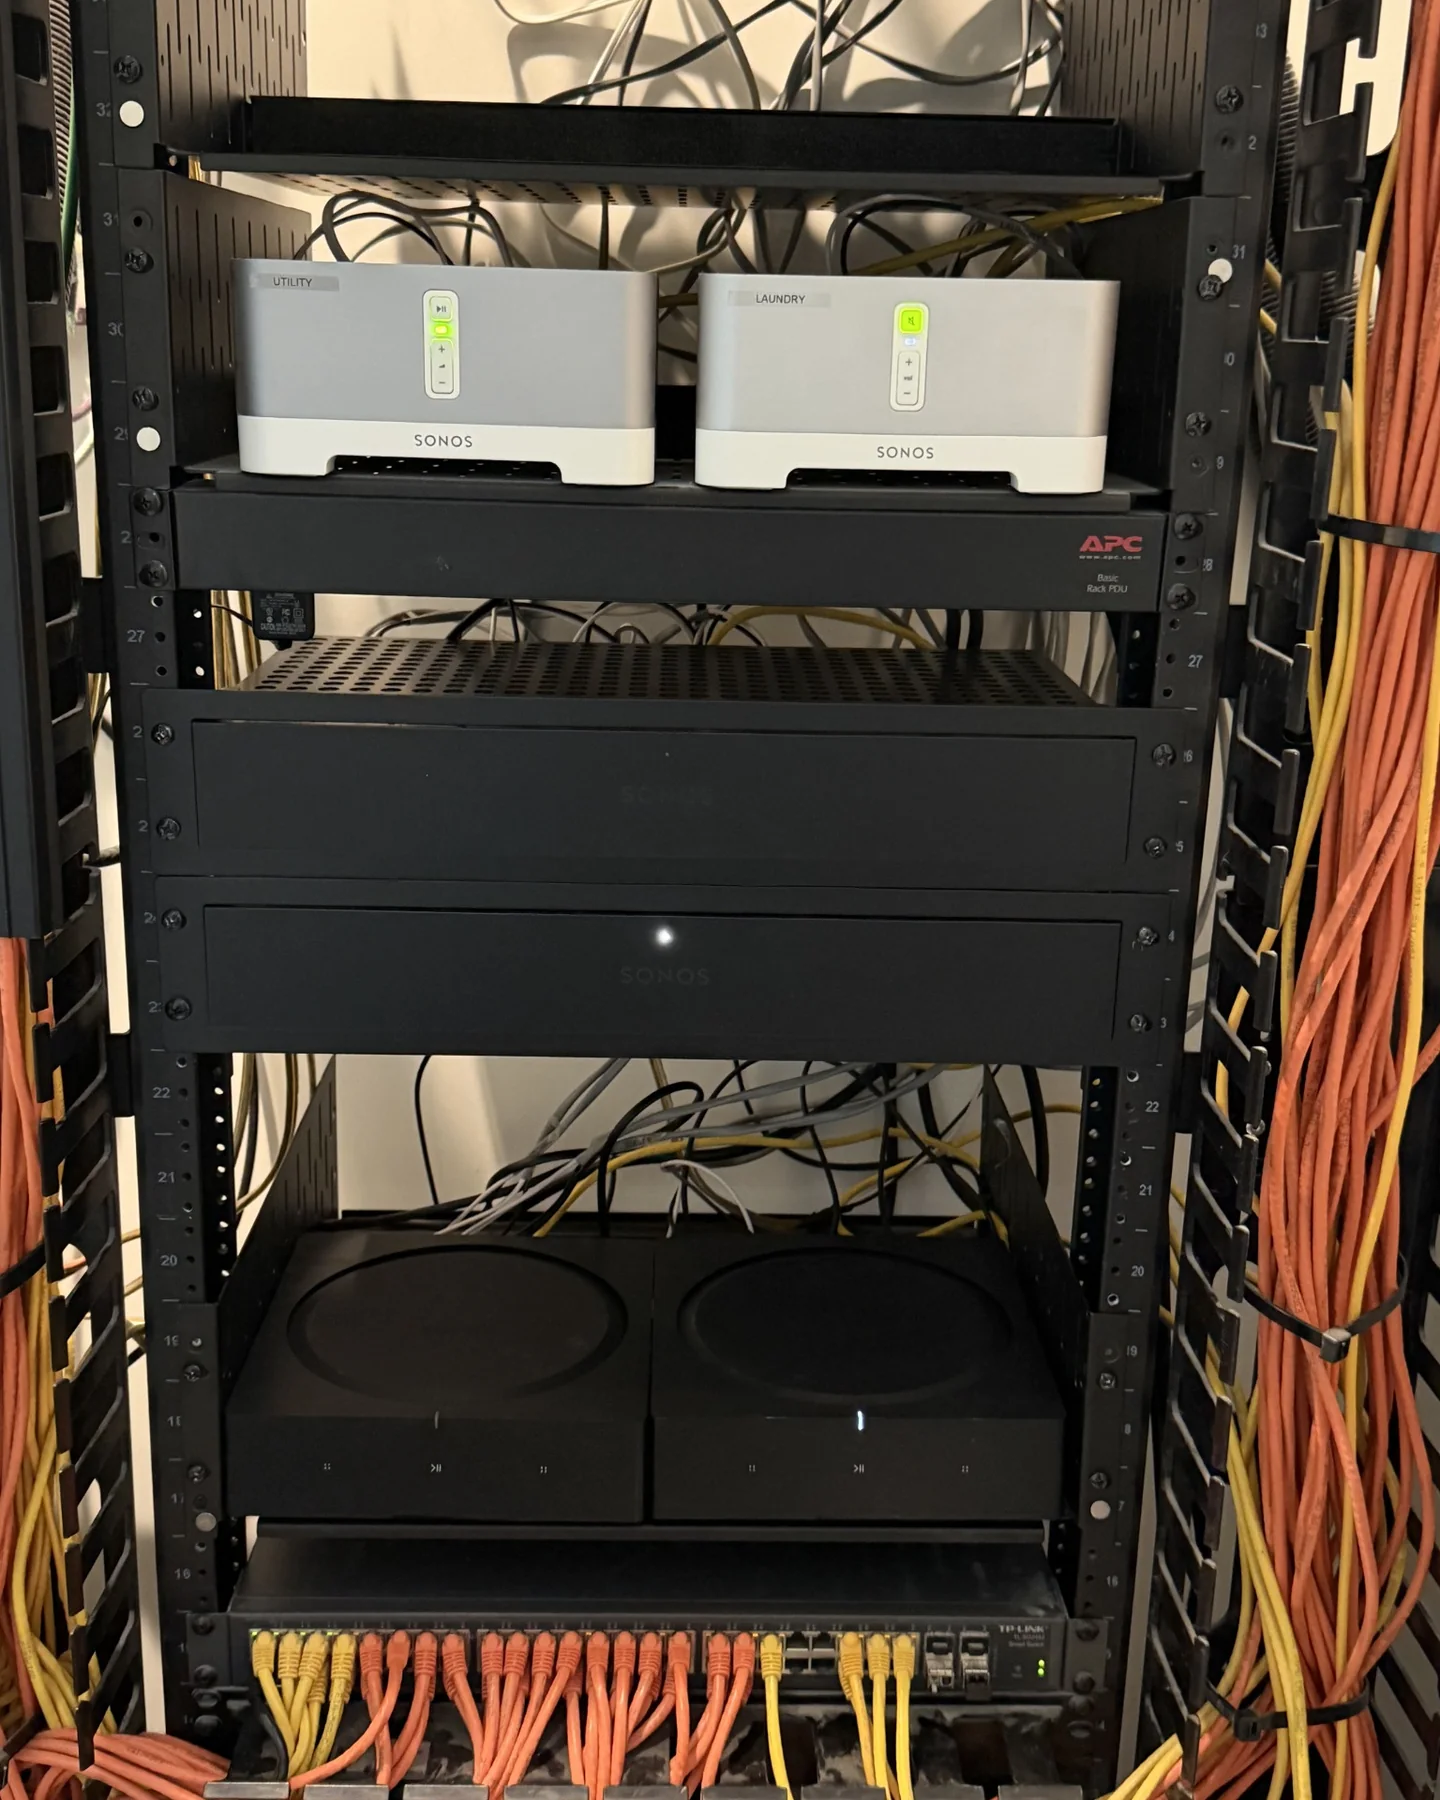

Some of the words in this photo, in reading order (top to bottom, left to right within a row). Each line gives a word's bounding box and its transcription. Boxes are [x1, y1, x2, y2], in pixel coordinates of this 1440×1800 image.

[1233, 244, 1246, 260] 31
[273, 276, 313, 287] UTILITY
[756, 294, 806, 304] LAUNDRY
[414, 434, 473, 448] SONOS
[877, 446, 934, 459] SONOS
[1080, 535, 1143, 553] APC
[1097, 573, 1119, 583] Basic
[1087, 584, 1106, 593] Rack
[1108, 584, 1128, 593] PDU
[127, 629, 146, 643] 27
[1188, 654, 1204, 669] 27
[619, 966, 710, 986] SONOS
[153, 1086, 171, 1099] 22
[1145, 1100, 1160, 1113] 22
[158, 1171, 176, 1183] 21
[1139, 1184, 1152, 1196] 21
[160, 1254, 178, 1267] 20
[1131, 1265, 1145, 1277] 20
[174, 1567, 191, 1580] 16
[1106, 1575, 1119, 1588] 16
